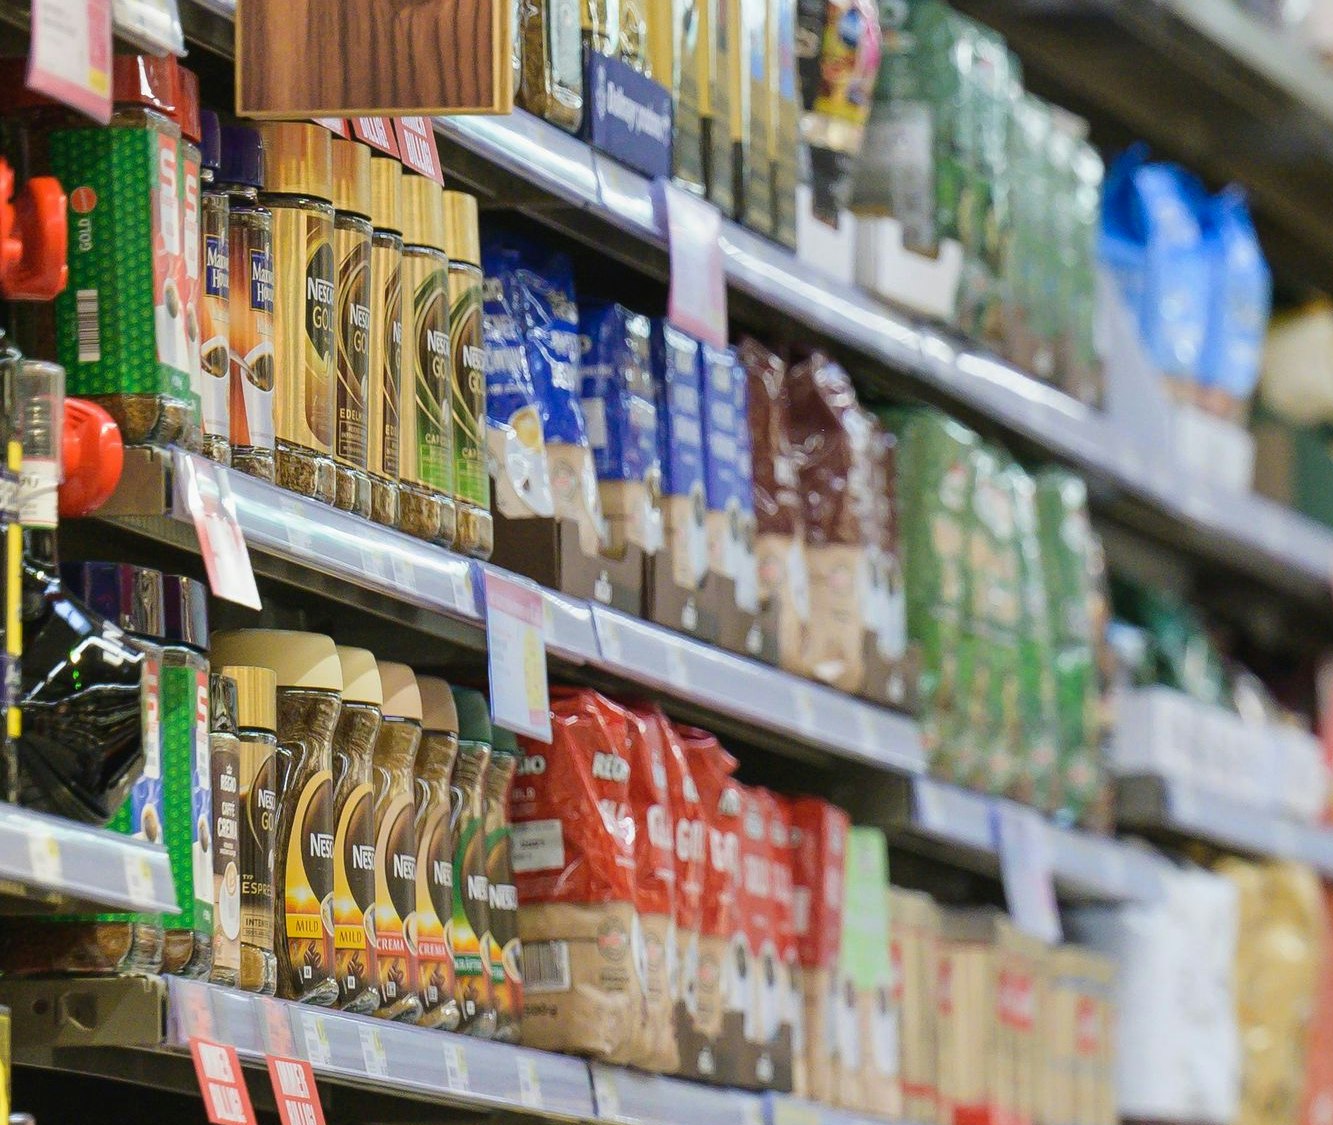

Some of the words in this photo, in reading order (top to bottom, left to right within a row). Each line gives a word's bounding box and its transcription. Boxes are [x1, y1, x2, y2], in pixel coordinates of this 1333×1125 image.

[77, 218, 92, 251] GOLD
[295, 918, 319, 934] MILD
[339, 929, 362, 944] MILD
